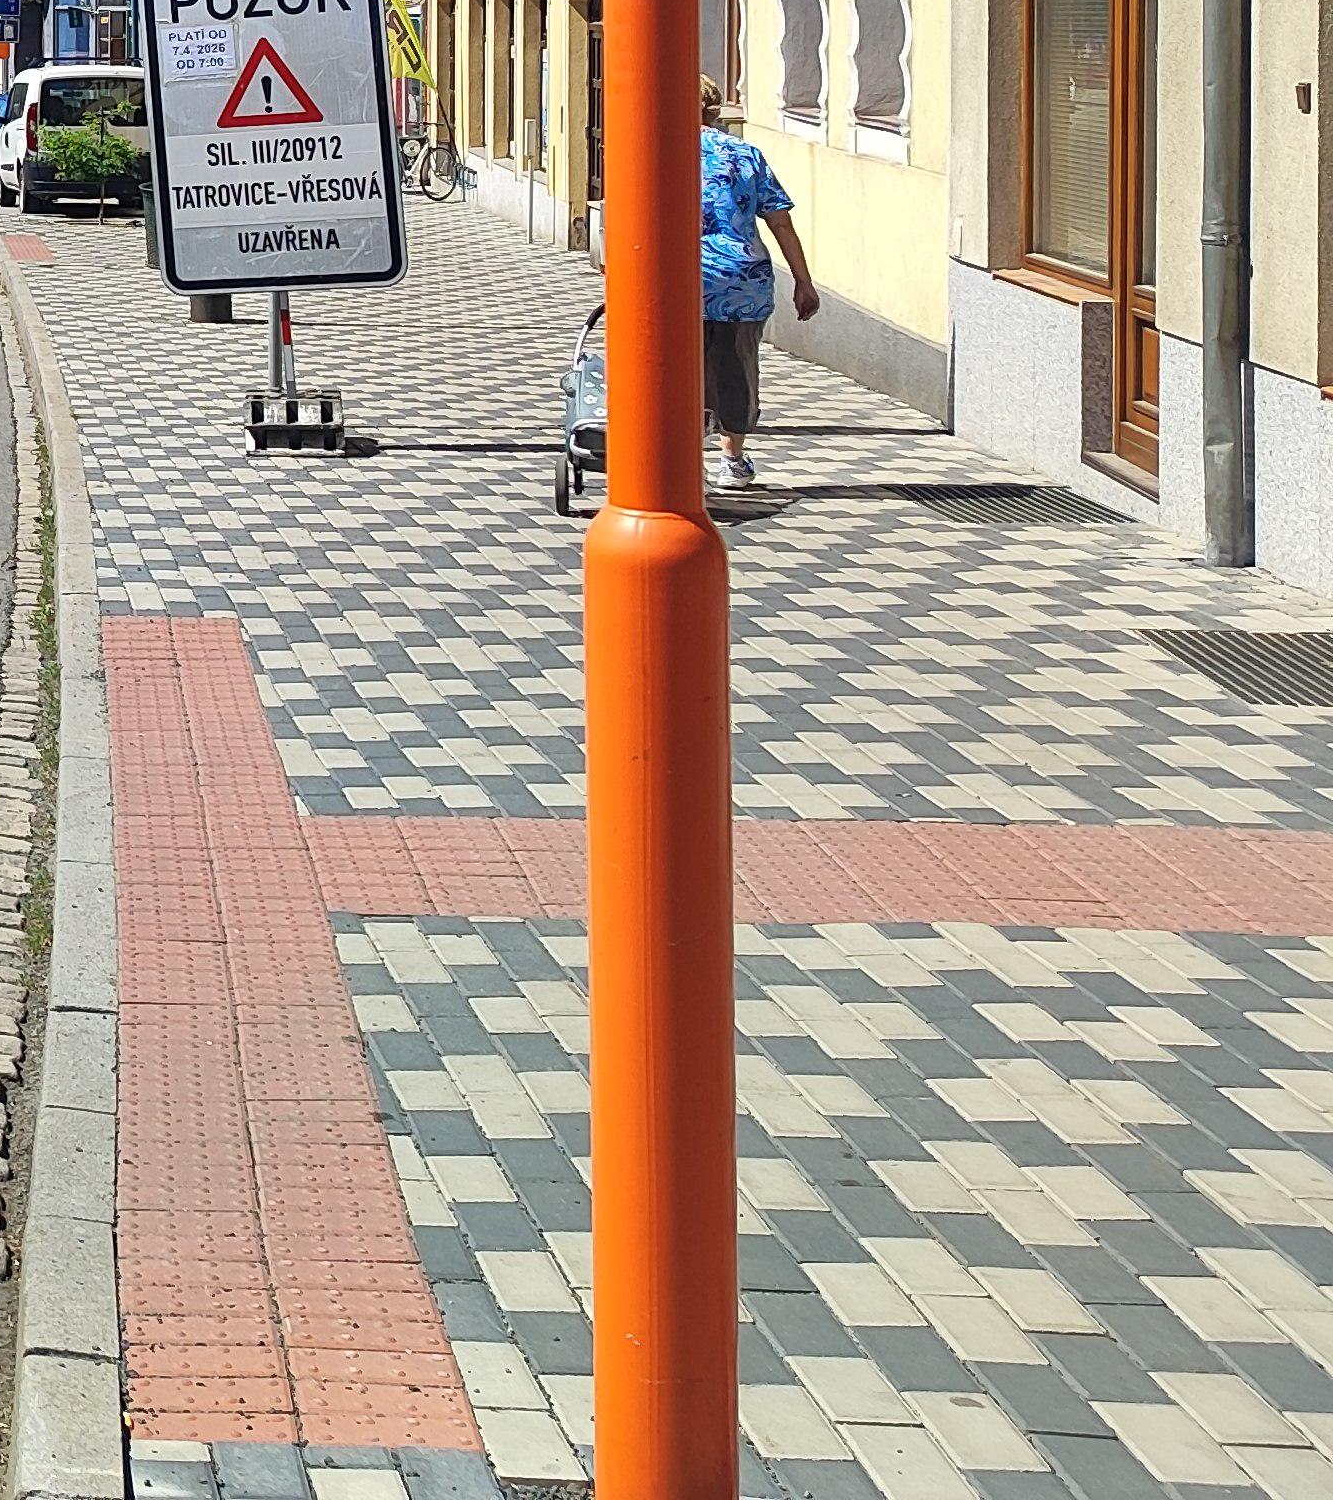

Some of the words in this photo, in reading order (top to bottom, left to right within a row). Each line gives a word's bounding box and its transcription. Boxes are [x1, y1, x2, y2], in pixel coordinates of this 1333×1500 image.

[168, 29, 205, 41] PLATÍ
[208, 29, 227, 39] OD
[197, 43, 226, 54] 2026
[176, 60, 195, 69] OD
[206, 142, 247, 166] SIL.
[252, 136, 343, 164] III/20912
[172, 171, 383, 210] TATROVICE-VŘESOVÁ
[238, 225, 341, 254] UZAVŘENA
